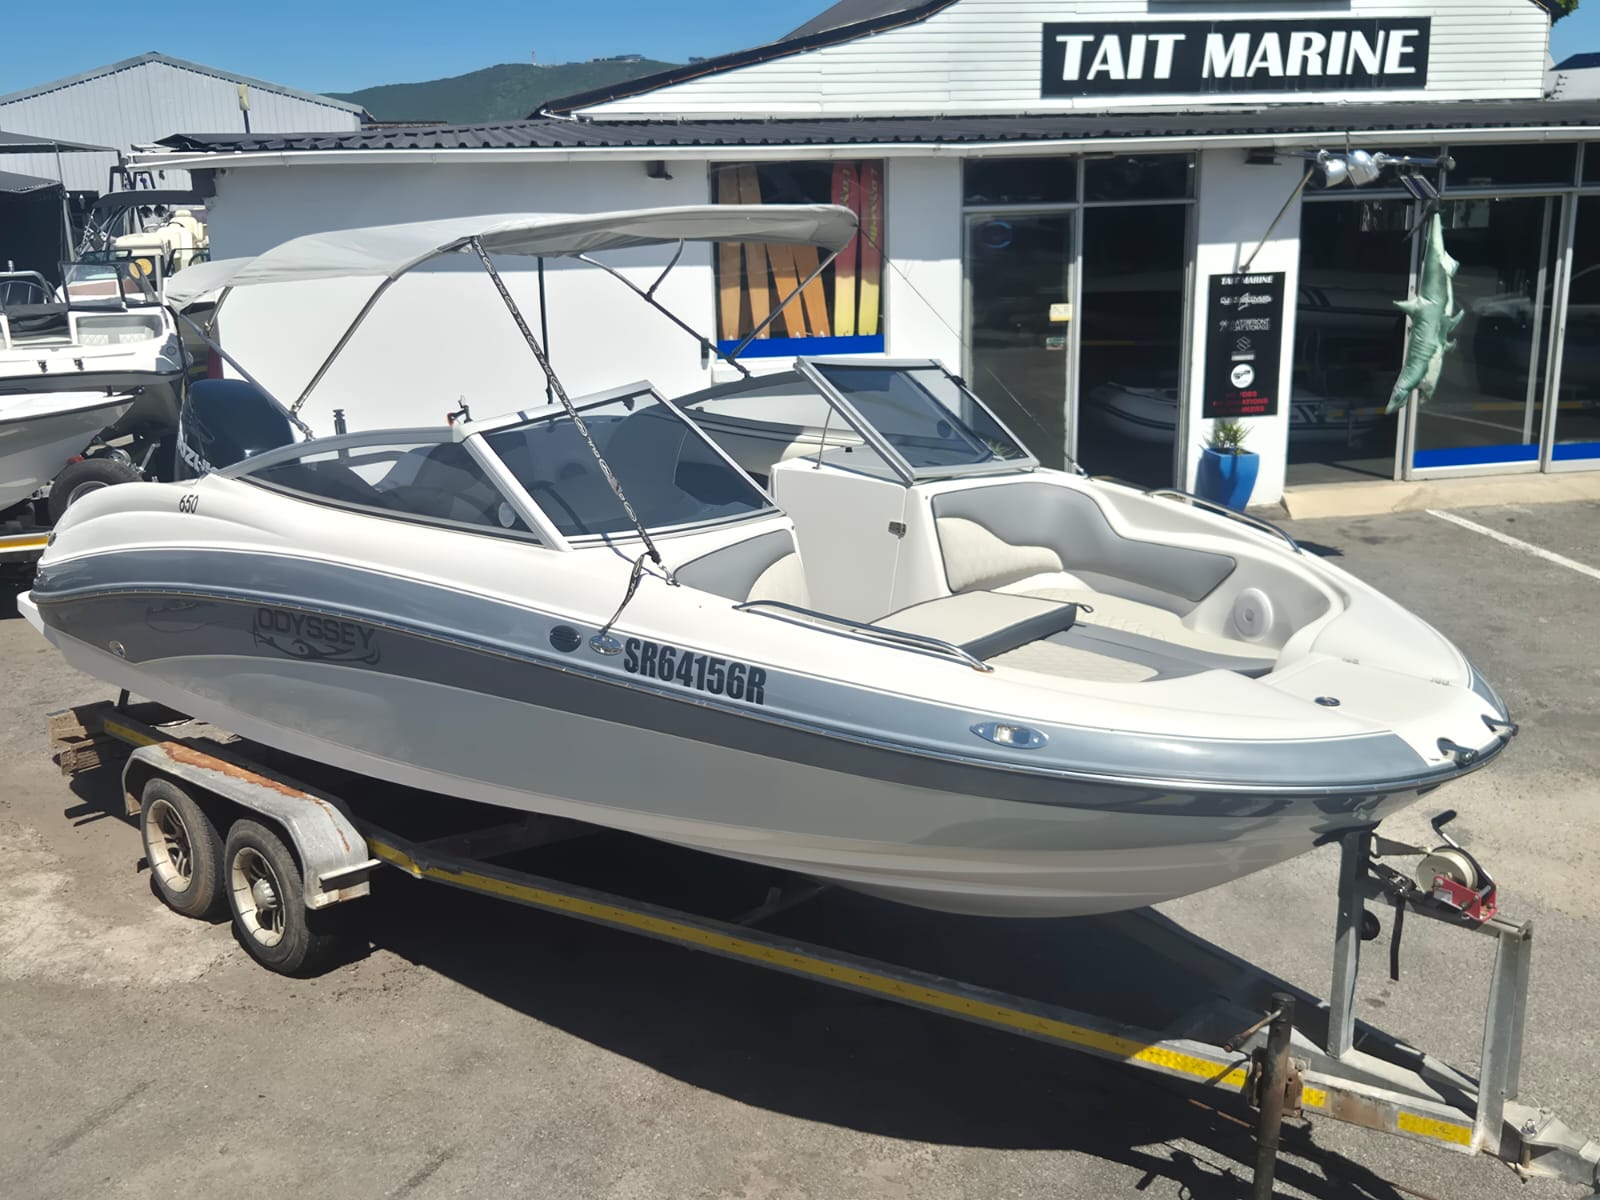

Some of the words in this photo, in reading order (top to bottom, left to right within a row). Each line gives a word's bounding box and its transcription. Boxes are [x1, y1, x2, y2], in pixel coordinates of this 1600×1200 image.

[1056, 33, 1186, 81] TAIT
[1202, 29, 1420, 79] MARINE
[179, 494, 200, 514] 650
[257, 607, 376, 649] ODYSSEY
[623, 637, 767, 705] SR64156R
